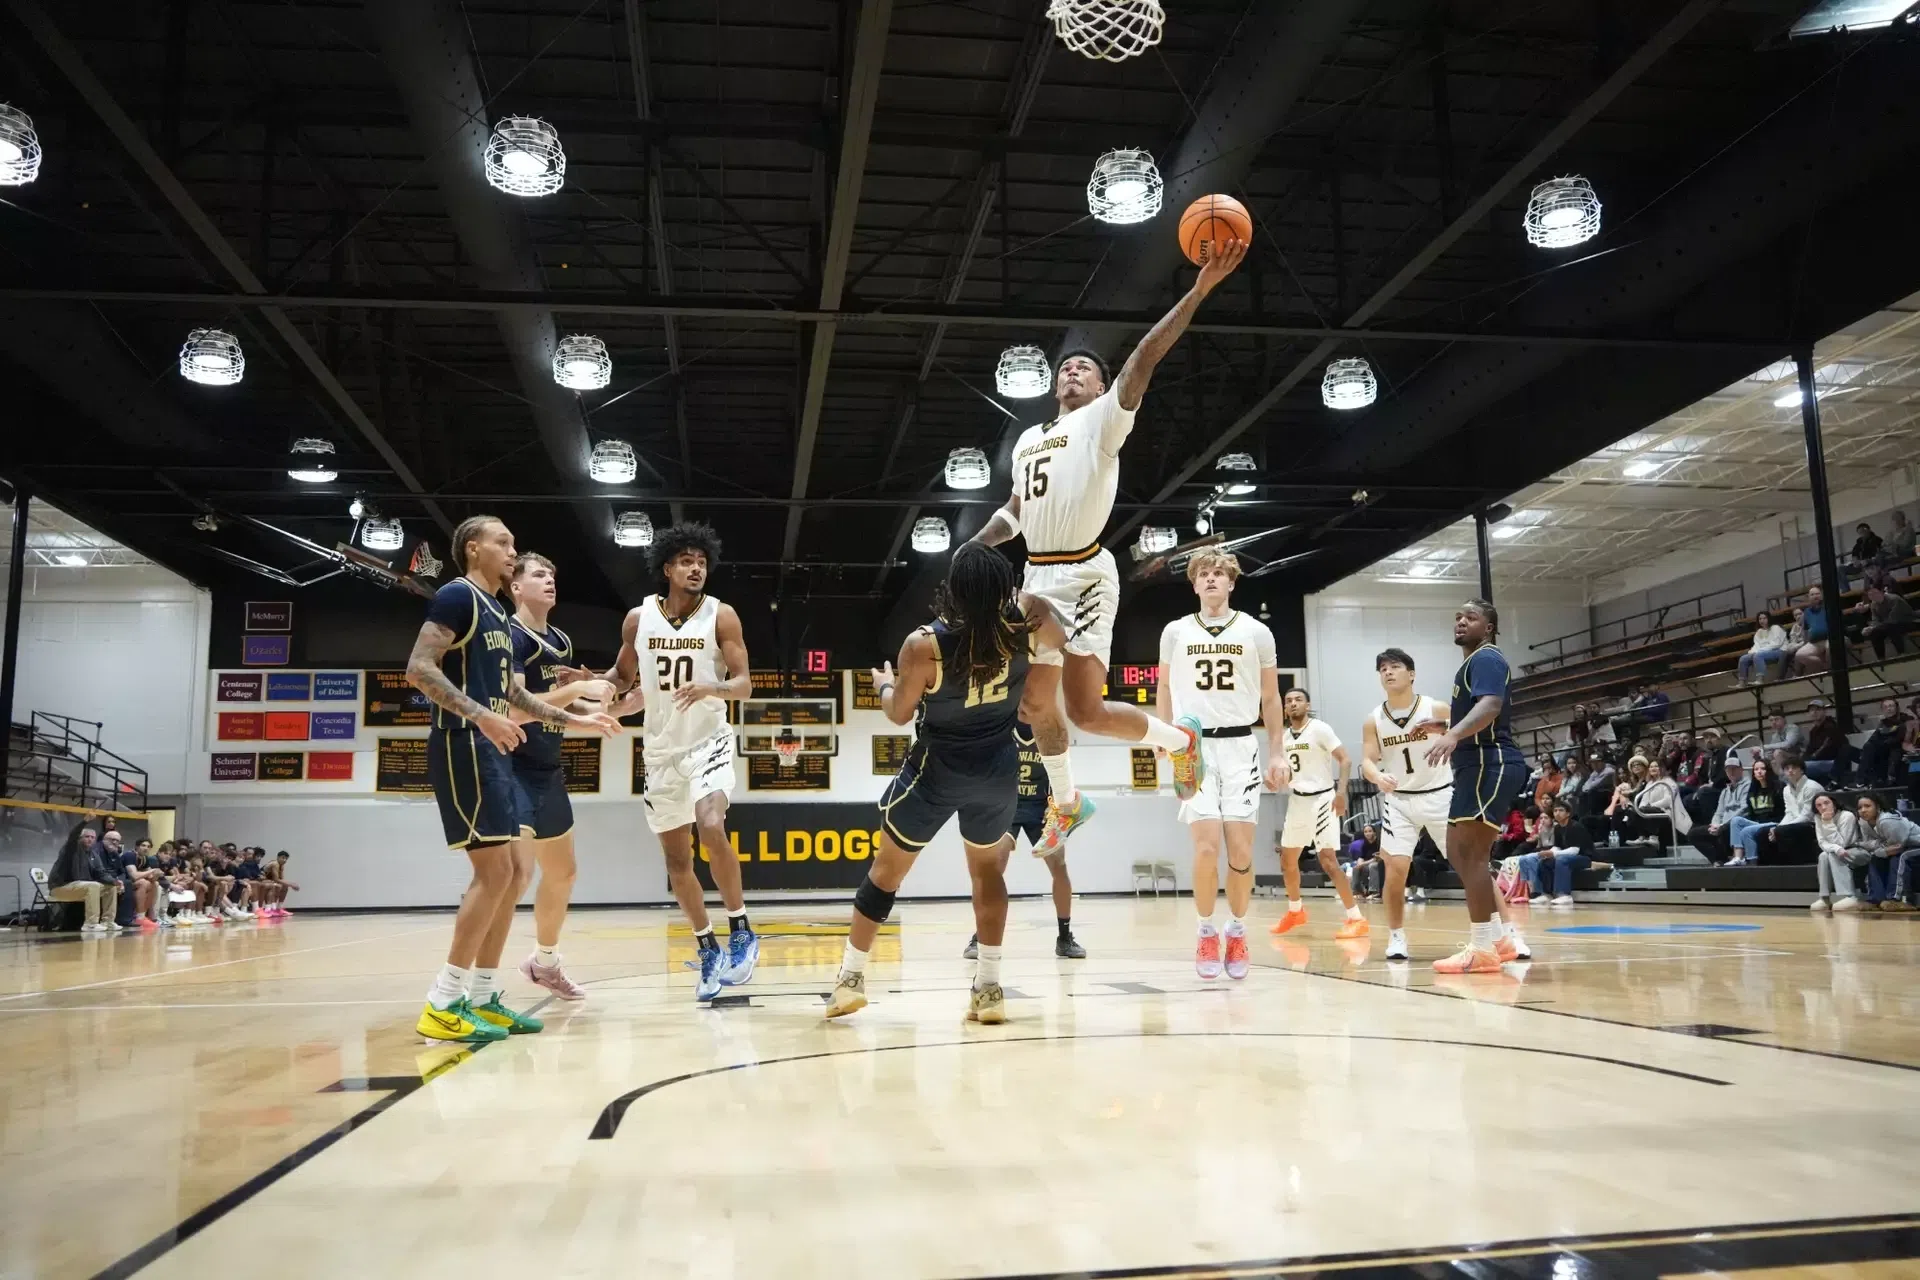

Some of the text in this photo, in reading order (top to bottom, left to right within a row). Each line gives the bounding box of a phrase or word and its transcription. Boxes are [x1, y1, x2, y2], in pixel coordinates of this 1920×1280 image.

[1018, 435, 1068, 460] BULLDOGS
[1025, 456, 1051, 501] 15
[251, 612, 286, 621] McMurry
[250, 646, 283, 655] Ozarks
[1186, 644, 1243, 655] BULLDOGS
[808, 651, 826, 672] 13
[656, 655, 694, 691] 20
[1195, 659, 1235, 691] 32
[221, 680, 259, 690] Centenary
[316, 678, 355, 687] University
[225, 690, 253, 699] College
[315, 716, 352, 725] Concordia
[227, 727, 255, 735] College
[322, 727, 344, 735] Texas
[215, 757, 252, 766] Schreiner
[263, 757, 298, 766] Colorado
[1402, 747, 1415, 774] 1
[214, 767, 253, 777] University
[266, 767, 295, 776] College
[690, 829, 882, 862] LLDOG
